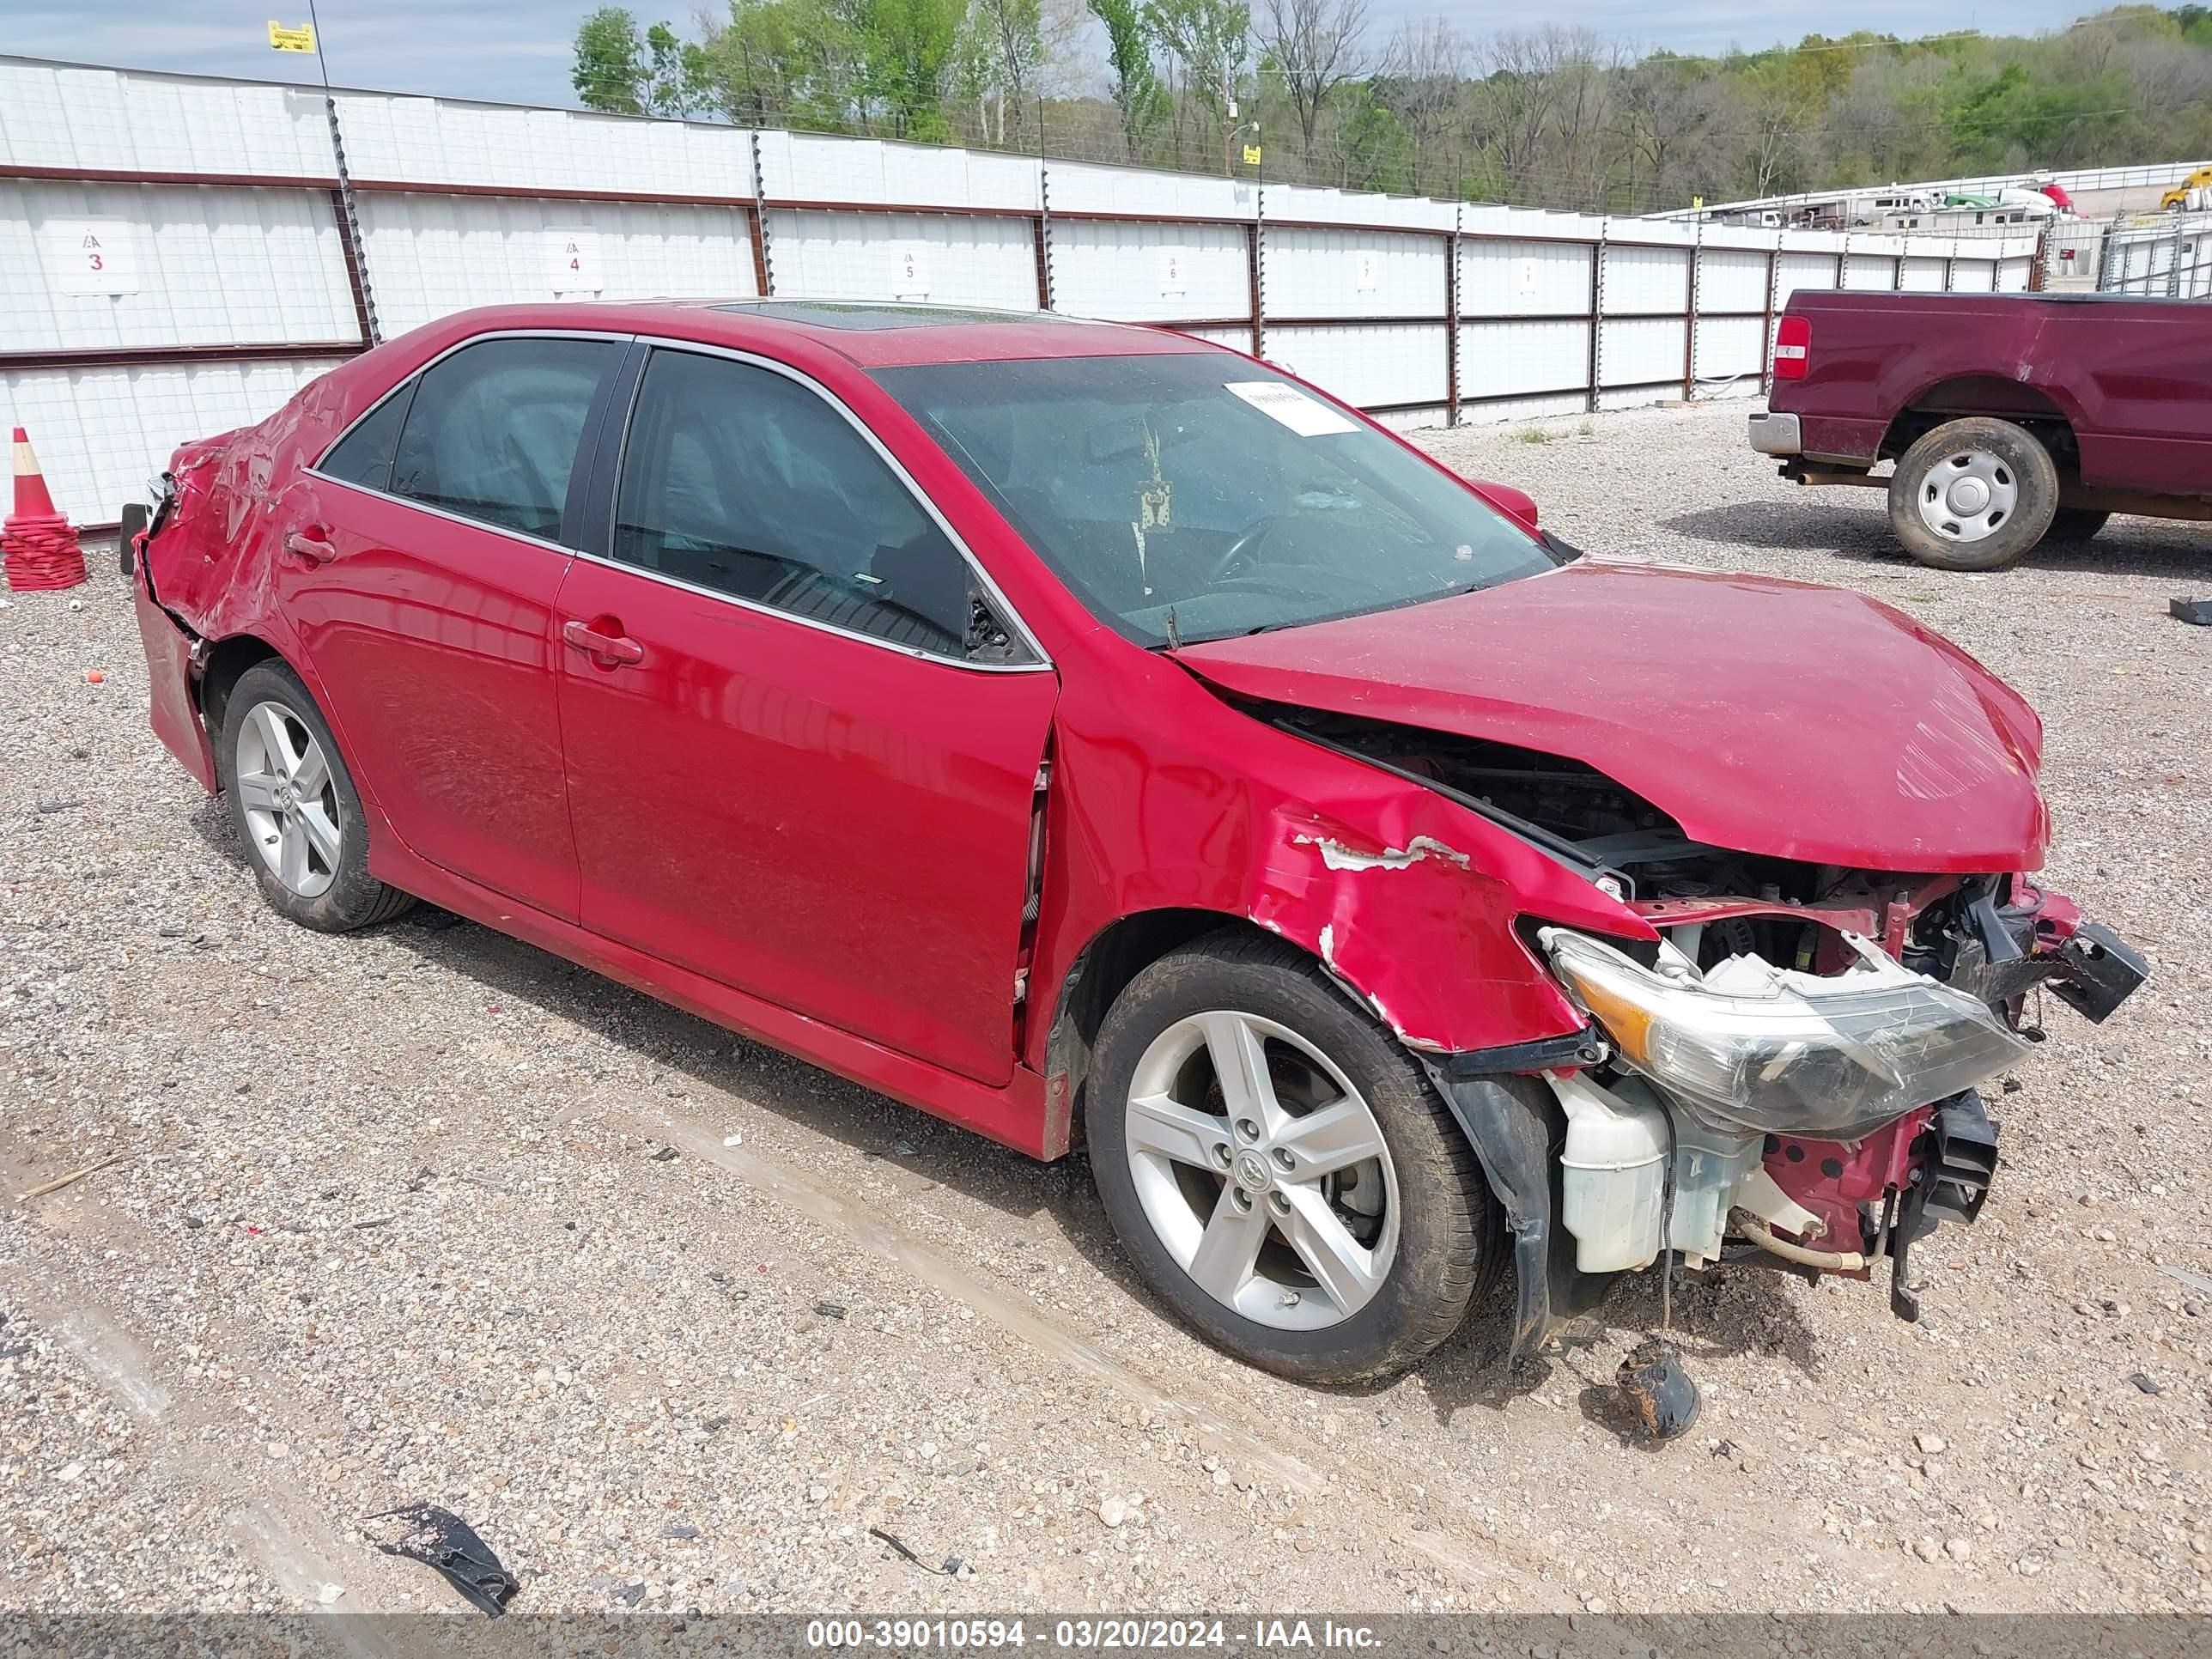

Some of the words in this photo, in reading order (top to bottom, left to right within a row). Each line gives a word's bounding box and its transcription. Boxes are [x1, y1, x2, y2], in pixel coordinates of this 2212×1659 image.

[88, 253, 103, 270] 3
[570, 258, 580, 271] 4
[907, 265, 914, 278] 5
[1170, 268, 1176, 279] 6
